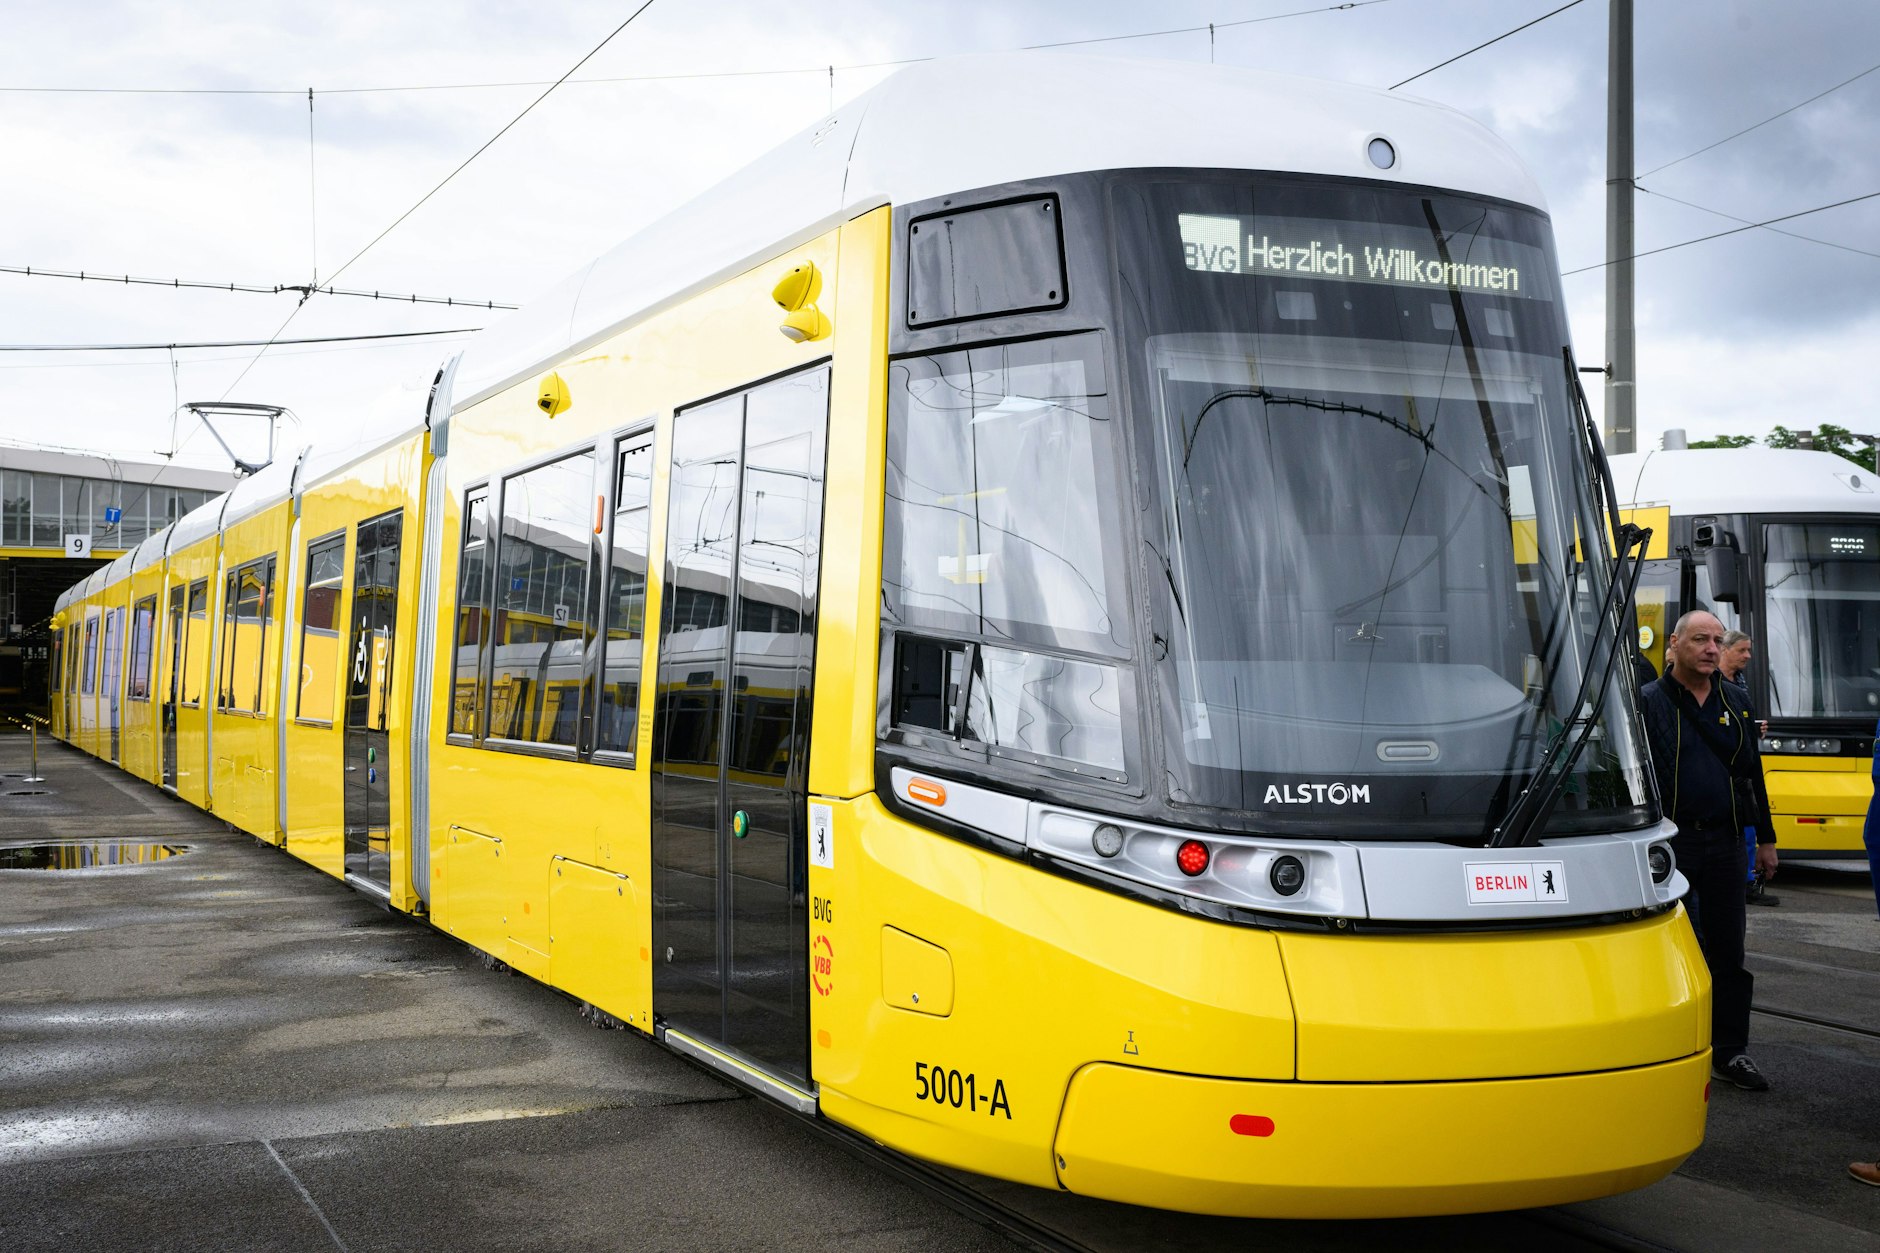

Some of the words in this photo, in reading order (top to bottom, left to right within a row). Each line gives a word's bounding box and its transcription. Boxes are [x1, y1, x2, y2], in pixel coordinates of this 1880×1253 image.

[1183, 242, 1237, 272] BVG
[1248, 235, 1354, 276] Herzlich
[1364, 246, 1519, 291] Willkommen
[110, 509, 119, 521] T
[74, 539, 83, 552] 9
[1264, 782, 1371, 805] ALSTOM
[1475, 875, 1528, 890] BERLIN
[813, 897, 832, 923] BVG
[815, 955, 831, 975] VBB
[915, 1062, 1012, 1120] 5001-A
